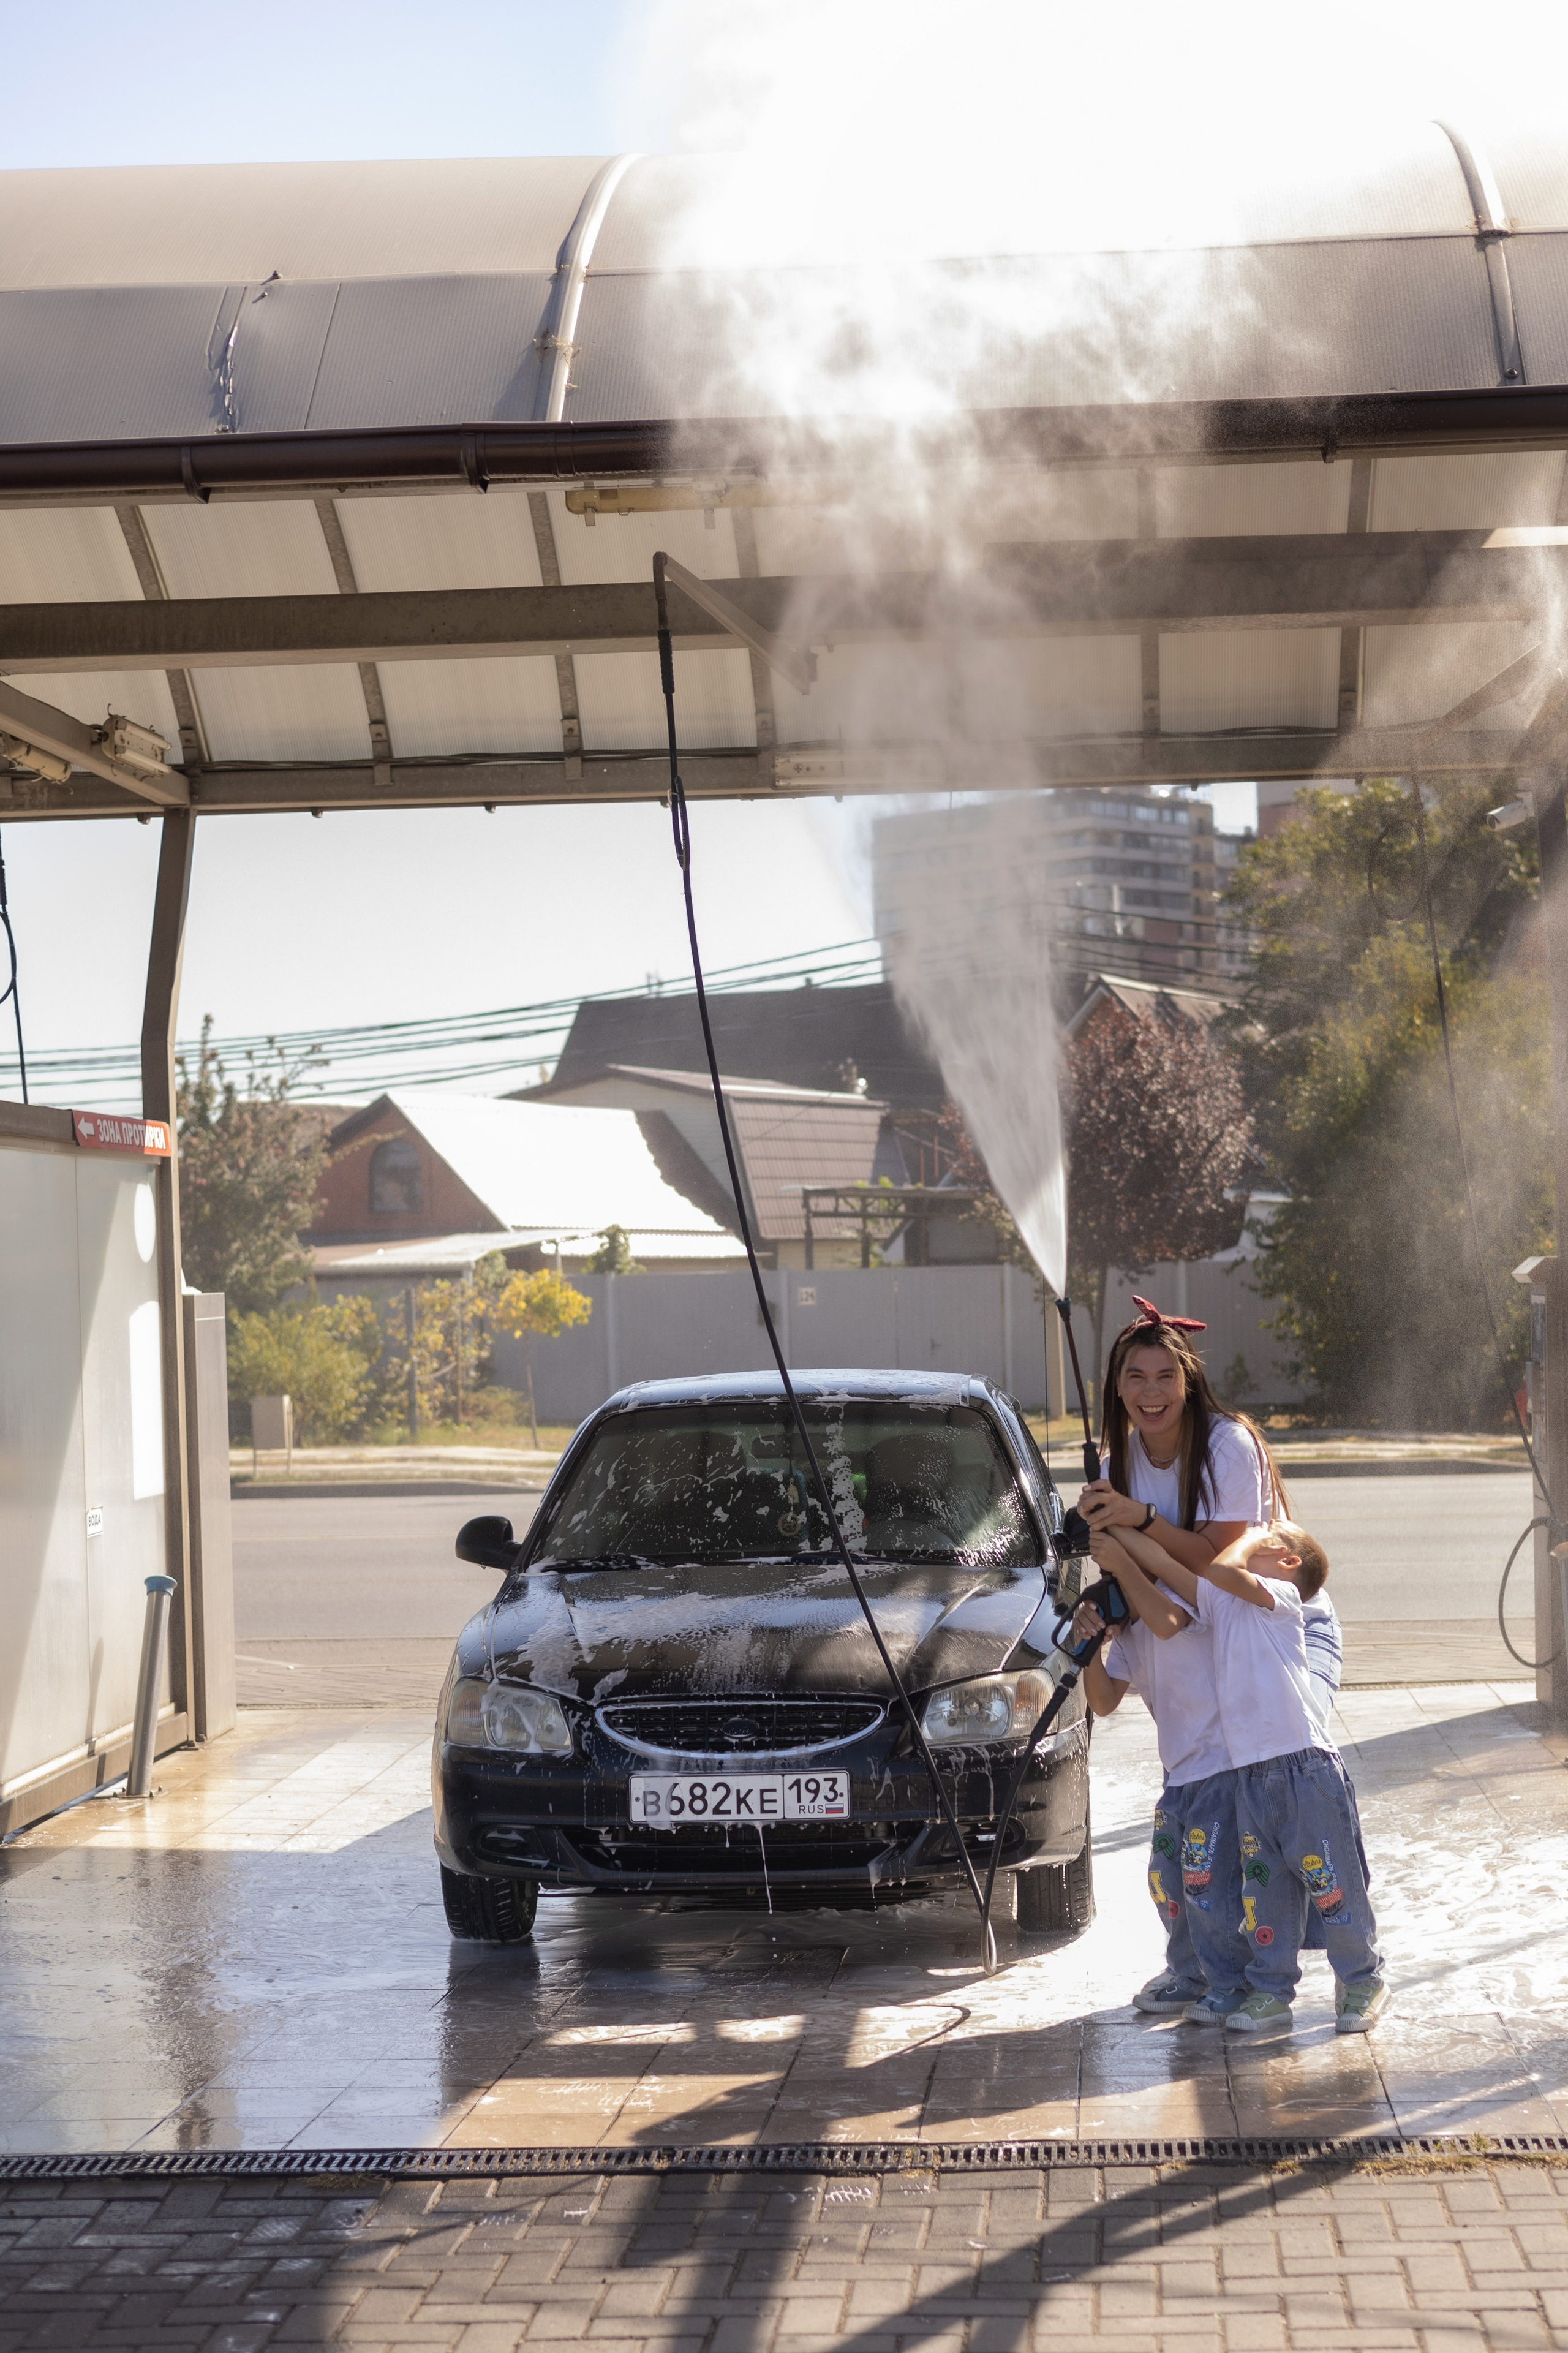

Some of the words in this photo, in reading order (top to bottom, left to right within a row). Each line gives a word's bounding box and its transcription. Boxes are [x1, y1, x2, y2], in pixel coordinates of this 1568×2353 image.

[97, 1118, 123, 1144] ЗОНА
[121, 1122, 166, 1149] ПРОТИРКИ
[88, 1514, 102, 1527] ВОДА
[788, 1777, 838, 1803] 193
[798, 1804, 824, 1815] RUS
